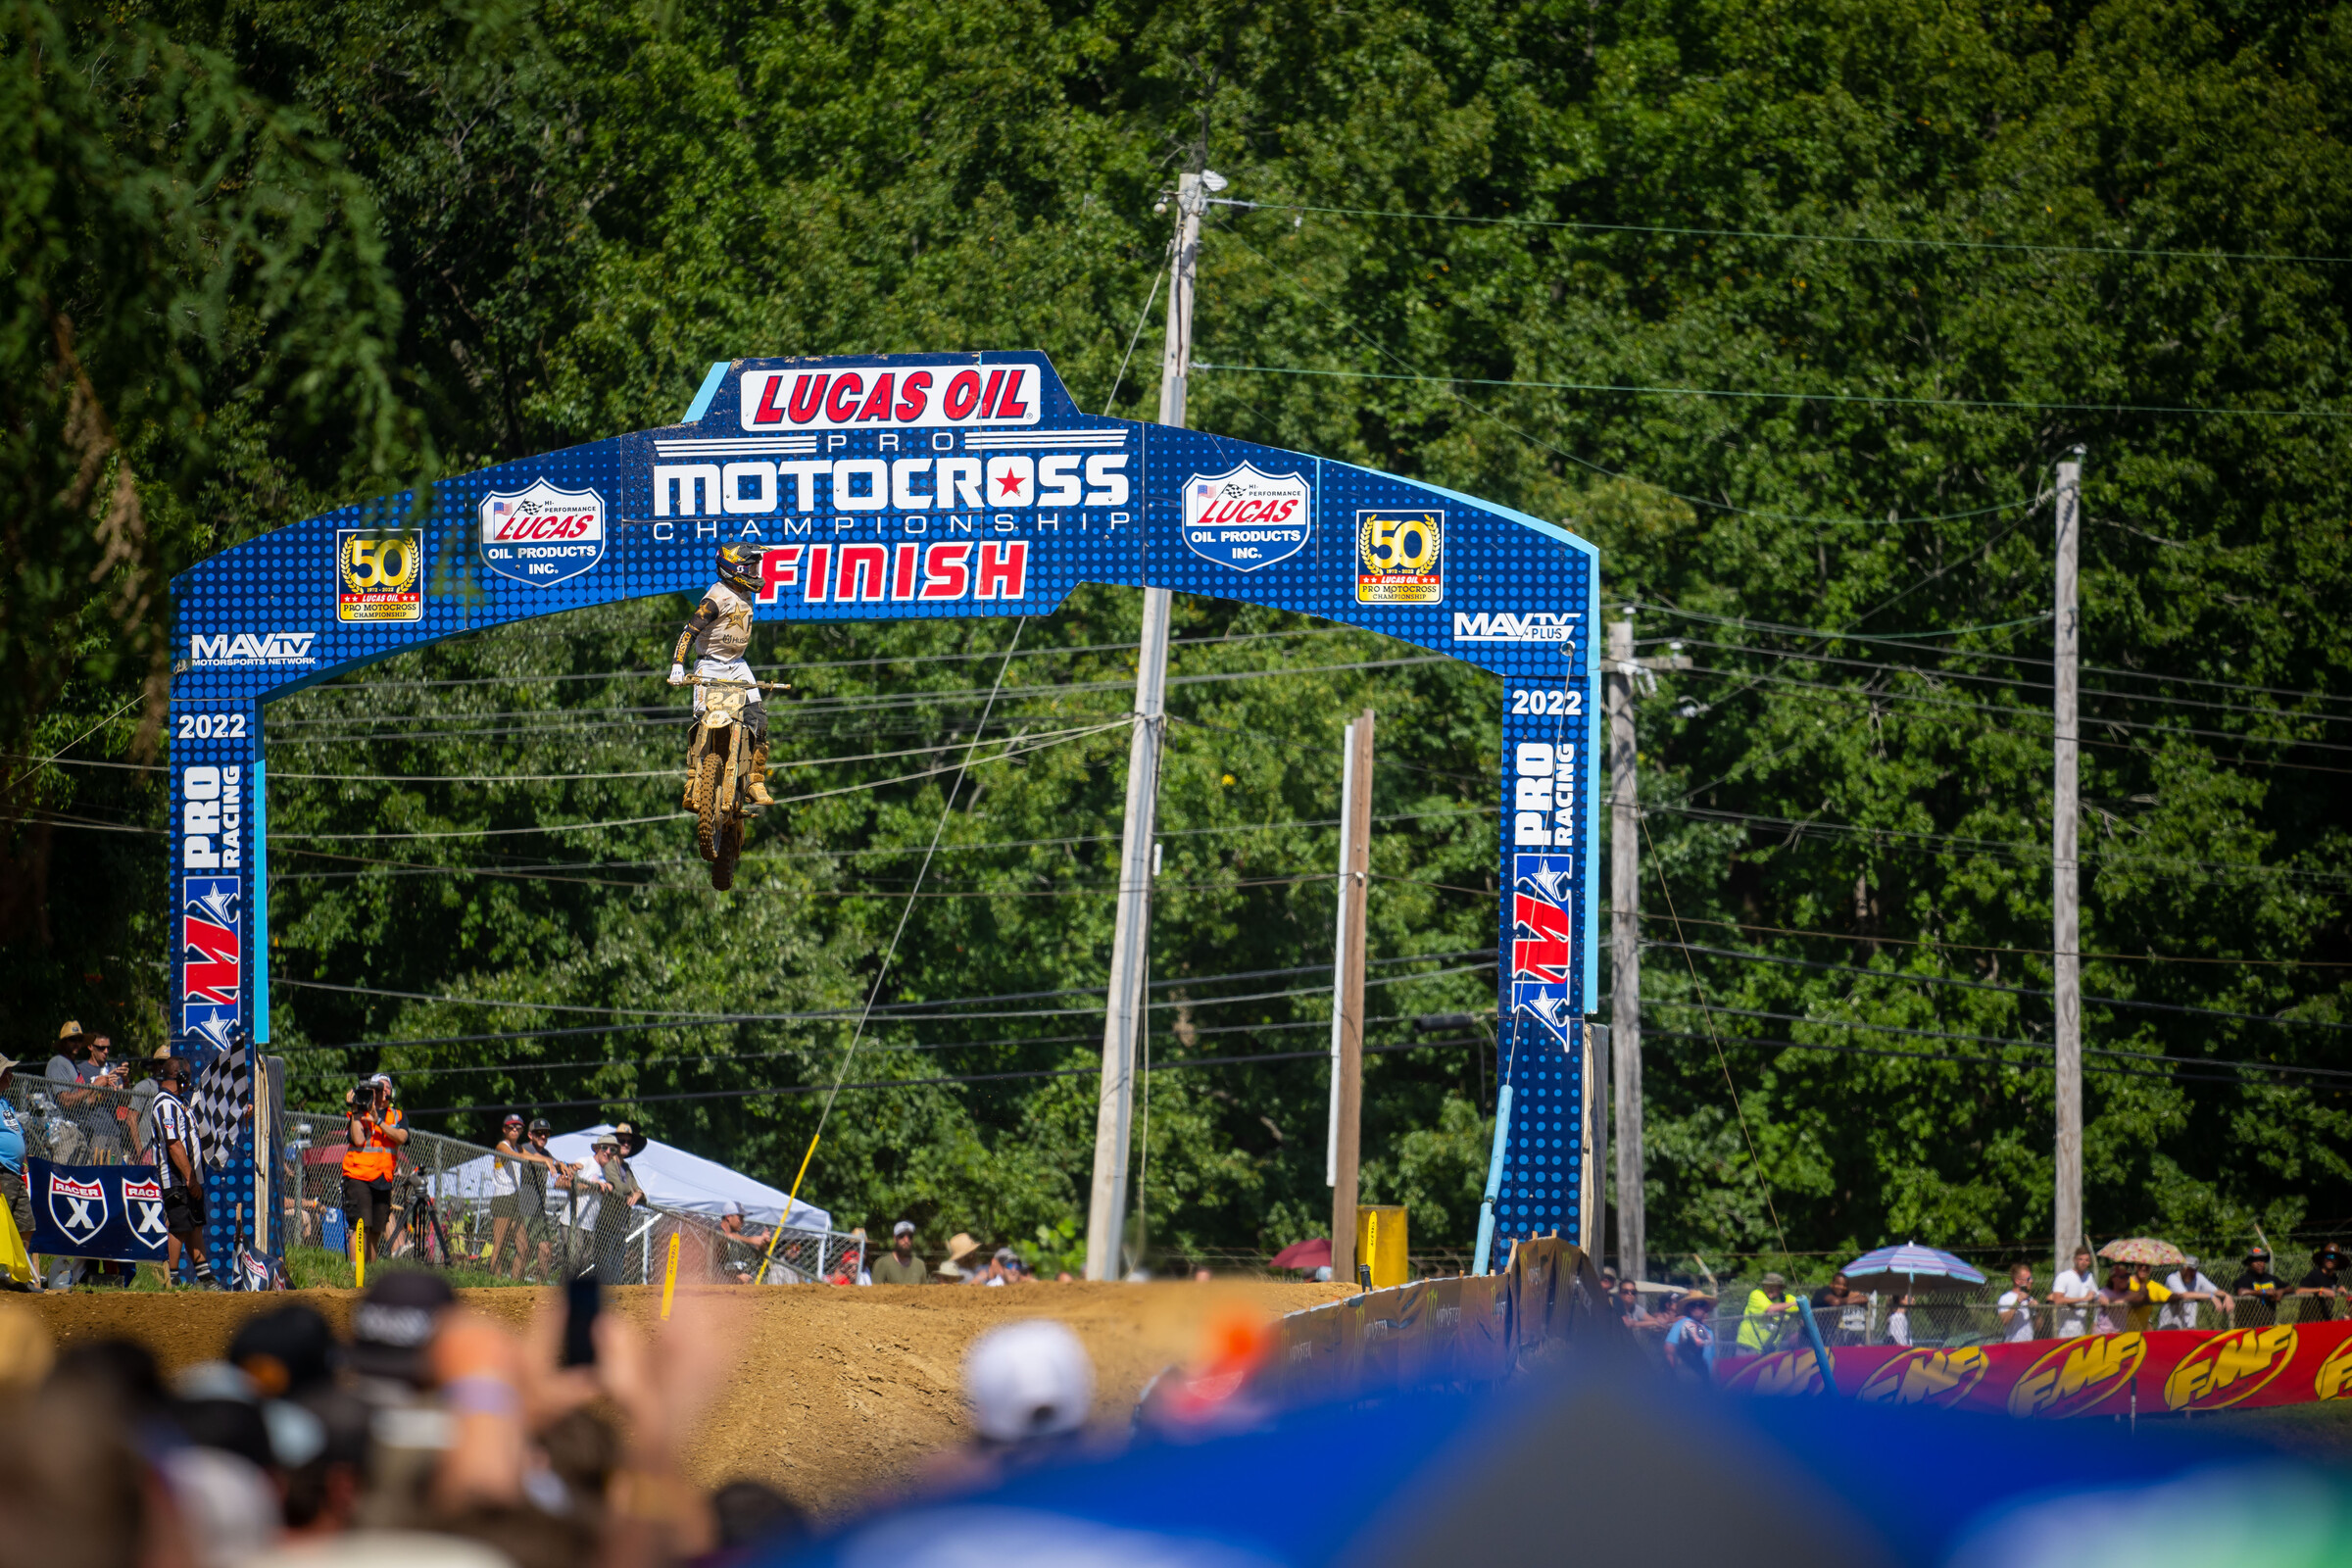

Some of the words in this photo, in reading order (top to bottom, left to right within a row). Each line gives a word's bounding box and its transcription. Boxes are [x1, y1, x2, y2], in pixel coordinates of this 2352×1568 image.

[752, 370, 934, 425] LUCAS
[943, 368, 1029, 421] OIL
[827, 432, 955, 452] PRO
[654, 454, 1129, 516] MOTOCROSS
[1197, 499, 1298, 523] LUCAS
[494, 514, 594, 540] LUCAS
[654, 512, 1130, 541] CHAMPIONSHIP
[1191, 531, 1216, 543] OIL
[1220, 530, 1301, 542] PRODUCTS
[488, 548, 514, 559] OIL
[517, 545, 597, 559] PRODUCTS
[1369, 520, 1433, 568] 50
[350, 539, 413, 588] 50
[755, 540, 1029, 605] FINISH
[1381, 575, 1405, 584] LUCAS
[1406, 575, 1419, 584] OIL
[364, 603, 416, 612] MOTOCROSS
[1453, 612, 1582, 636] MAVTV
[1531, 627, 1562, 639] PLUS
[191, 632, 316, 659] MAVTV
[191, 658, 266, 666] MOTORSPORTS
[707, 692, 742, 710] 24
[1511, 689, 1582, 715] 2022
[177, 713, 246, 739] 2022
[1514, 742, 1554, 846] PRO
[1554, 743, 1575, 846] RACING
[183, 765, 220, 869] PRO
[222, 765, 240, 868] RACING
[55, 1182, 100, 1197] RACER
[127, 1187, 162, 1198] RACE
[64, 1197, 95, 1229] X
[137, 1201, 168, 1233] X
[668, 1244, 677, 1275] ACERBIS
[2015, 1331, 2142, 1418] FMF
[2169, 1324, 2294, 1411] FMF
